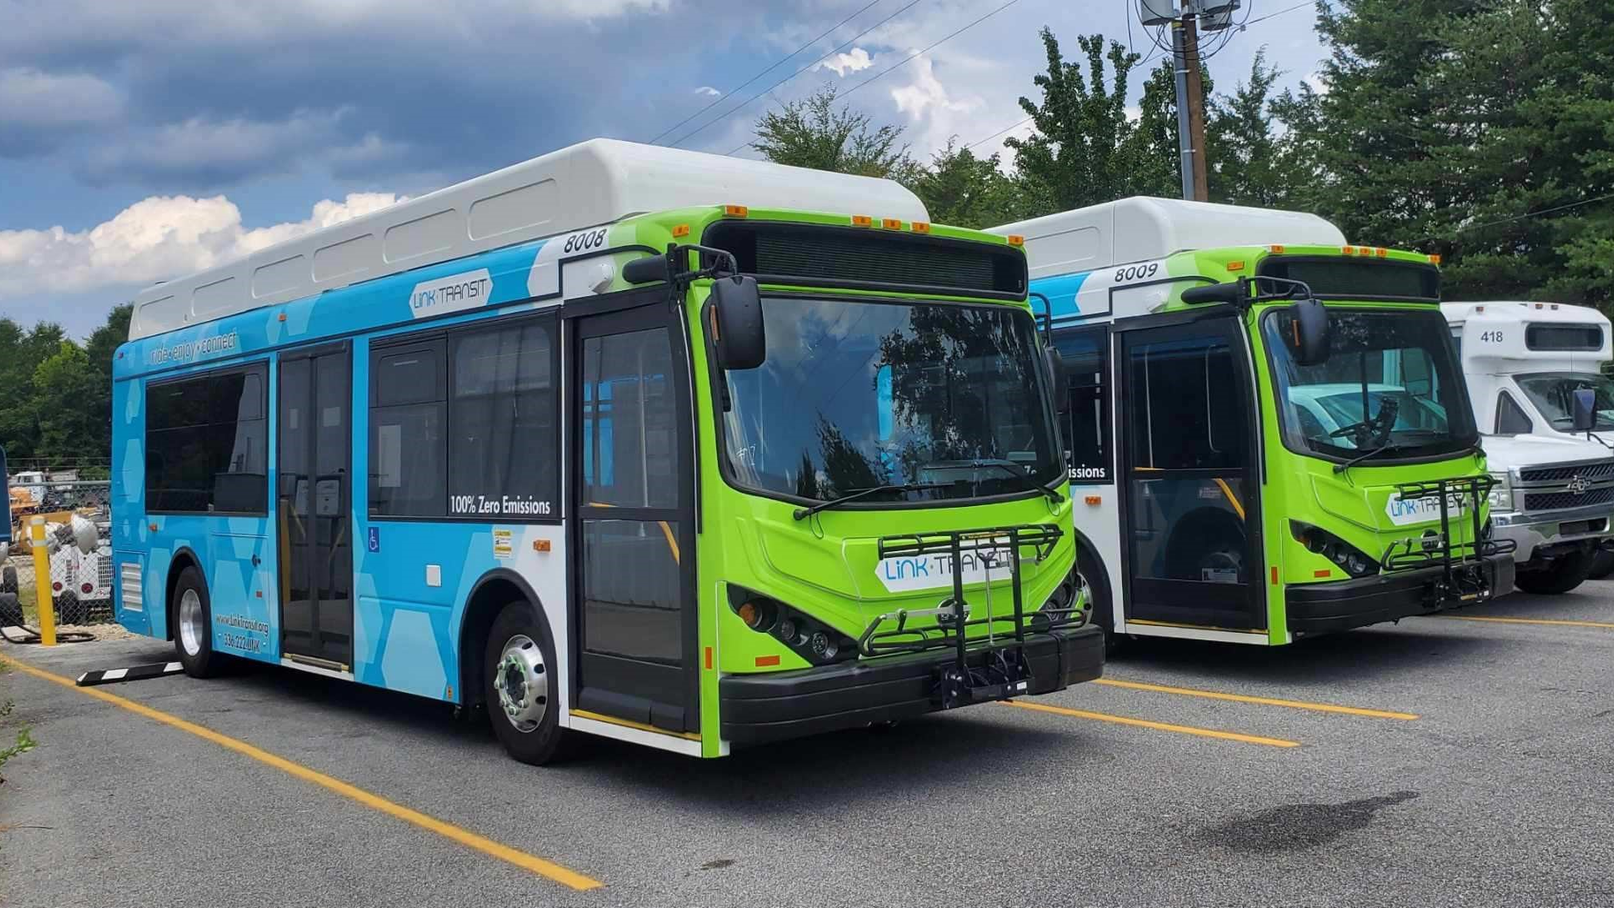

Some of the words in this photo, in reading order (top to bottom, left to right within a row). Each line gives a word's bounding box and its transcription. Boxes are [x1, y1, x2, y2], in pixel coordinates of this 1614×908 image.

[563, 228, 608, 254] 8008
[1114, 262, 1159, 283] 8009
[438, 278, 488, 305] TRANSIT
[150, 342, 169, 365] ride
[172, 339, 196, 363] enjoy
[201, 328, 237, 354] connect
[1480, 330, 1504, 343] 418
[1067, 463, 1106, 479] issions
[450, 495, 477, 514] 100%
[478, 495, 500, 514] Zero
[502, 494, 551, 515] Emissions
